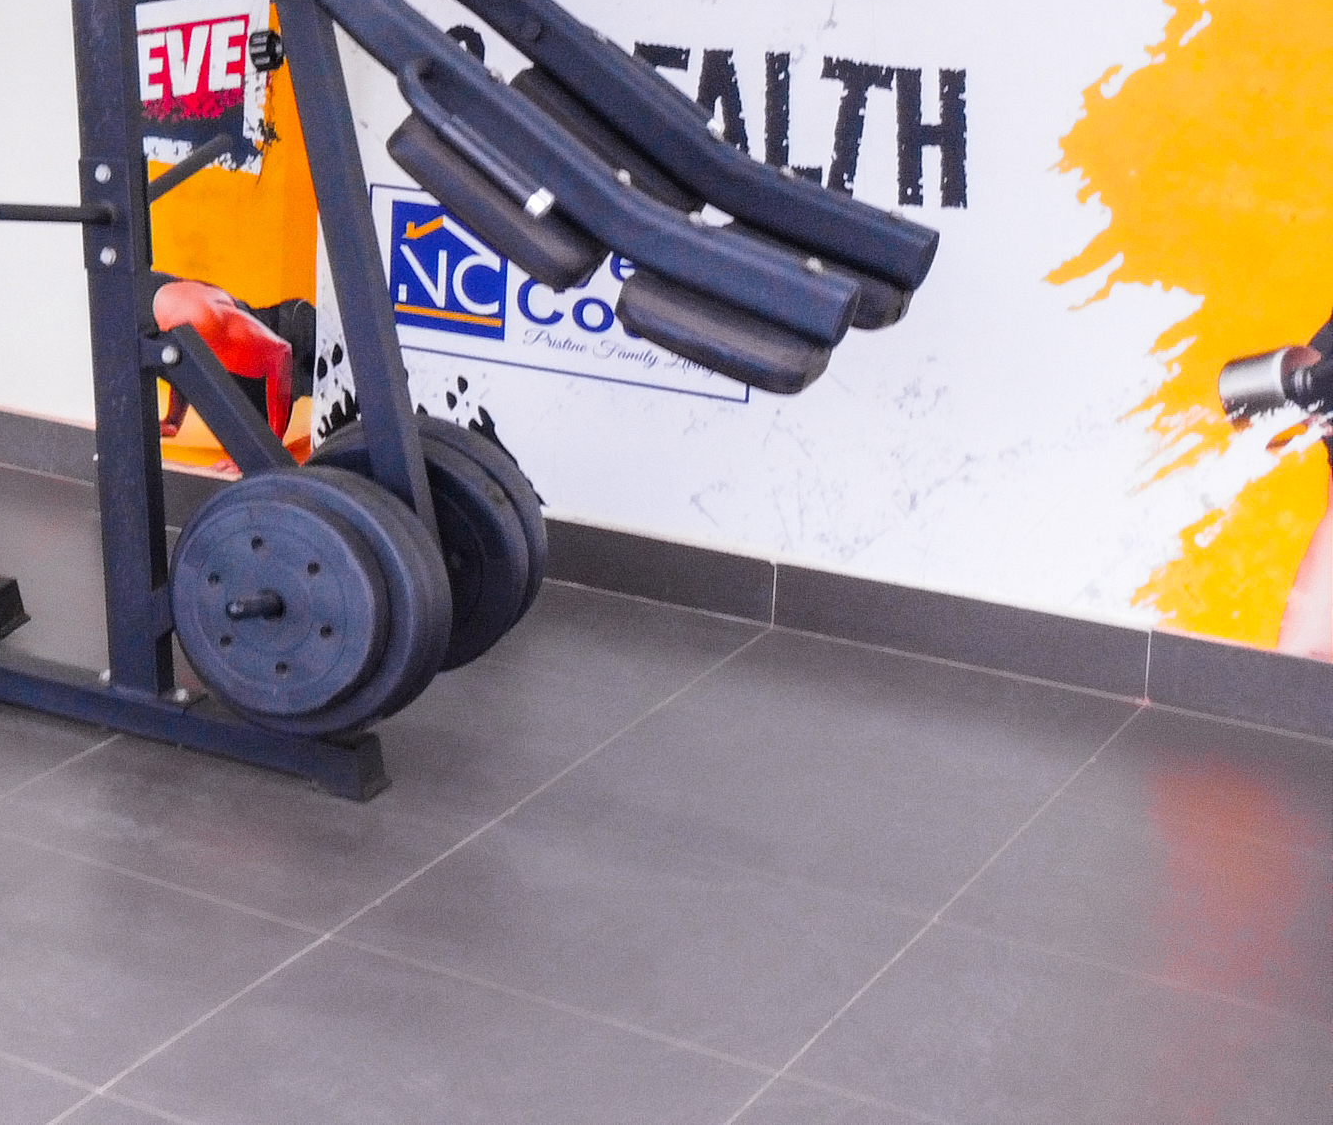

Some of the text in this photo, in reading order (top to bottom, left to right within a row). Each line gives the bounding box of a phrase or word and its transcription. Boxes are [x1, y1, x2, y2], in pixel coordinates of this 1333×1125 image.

[139, 20, 247, 102] EVE
[633, 40, 968, 209] ALTH
[522, 327, 588, 355] Pristine
[592, 338, 659, 369] Family
